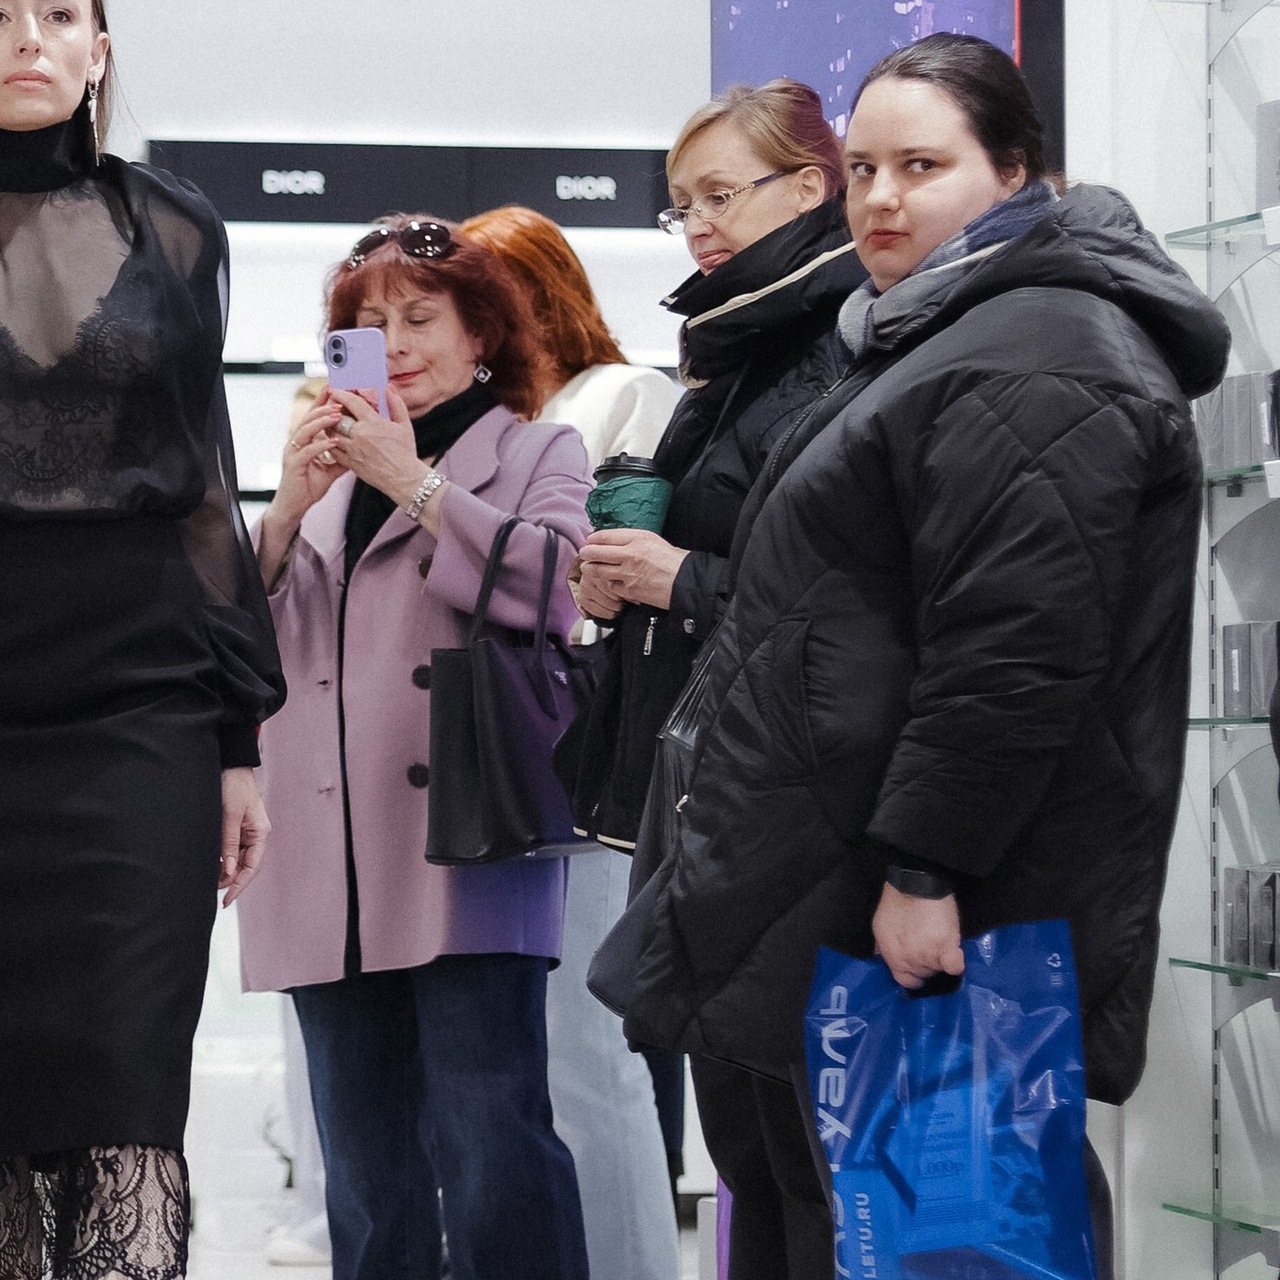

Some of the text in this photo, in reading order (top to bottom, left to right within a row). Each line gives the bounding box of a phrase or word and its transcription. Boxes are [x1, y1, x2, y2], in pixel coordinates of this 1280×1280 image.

[262, 169, 326, 195] DIOR
[555, 175, 617, 200] DIOR
[855, 1192, 877, 1279] LETU.RU
